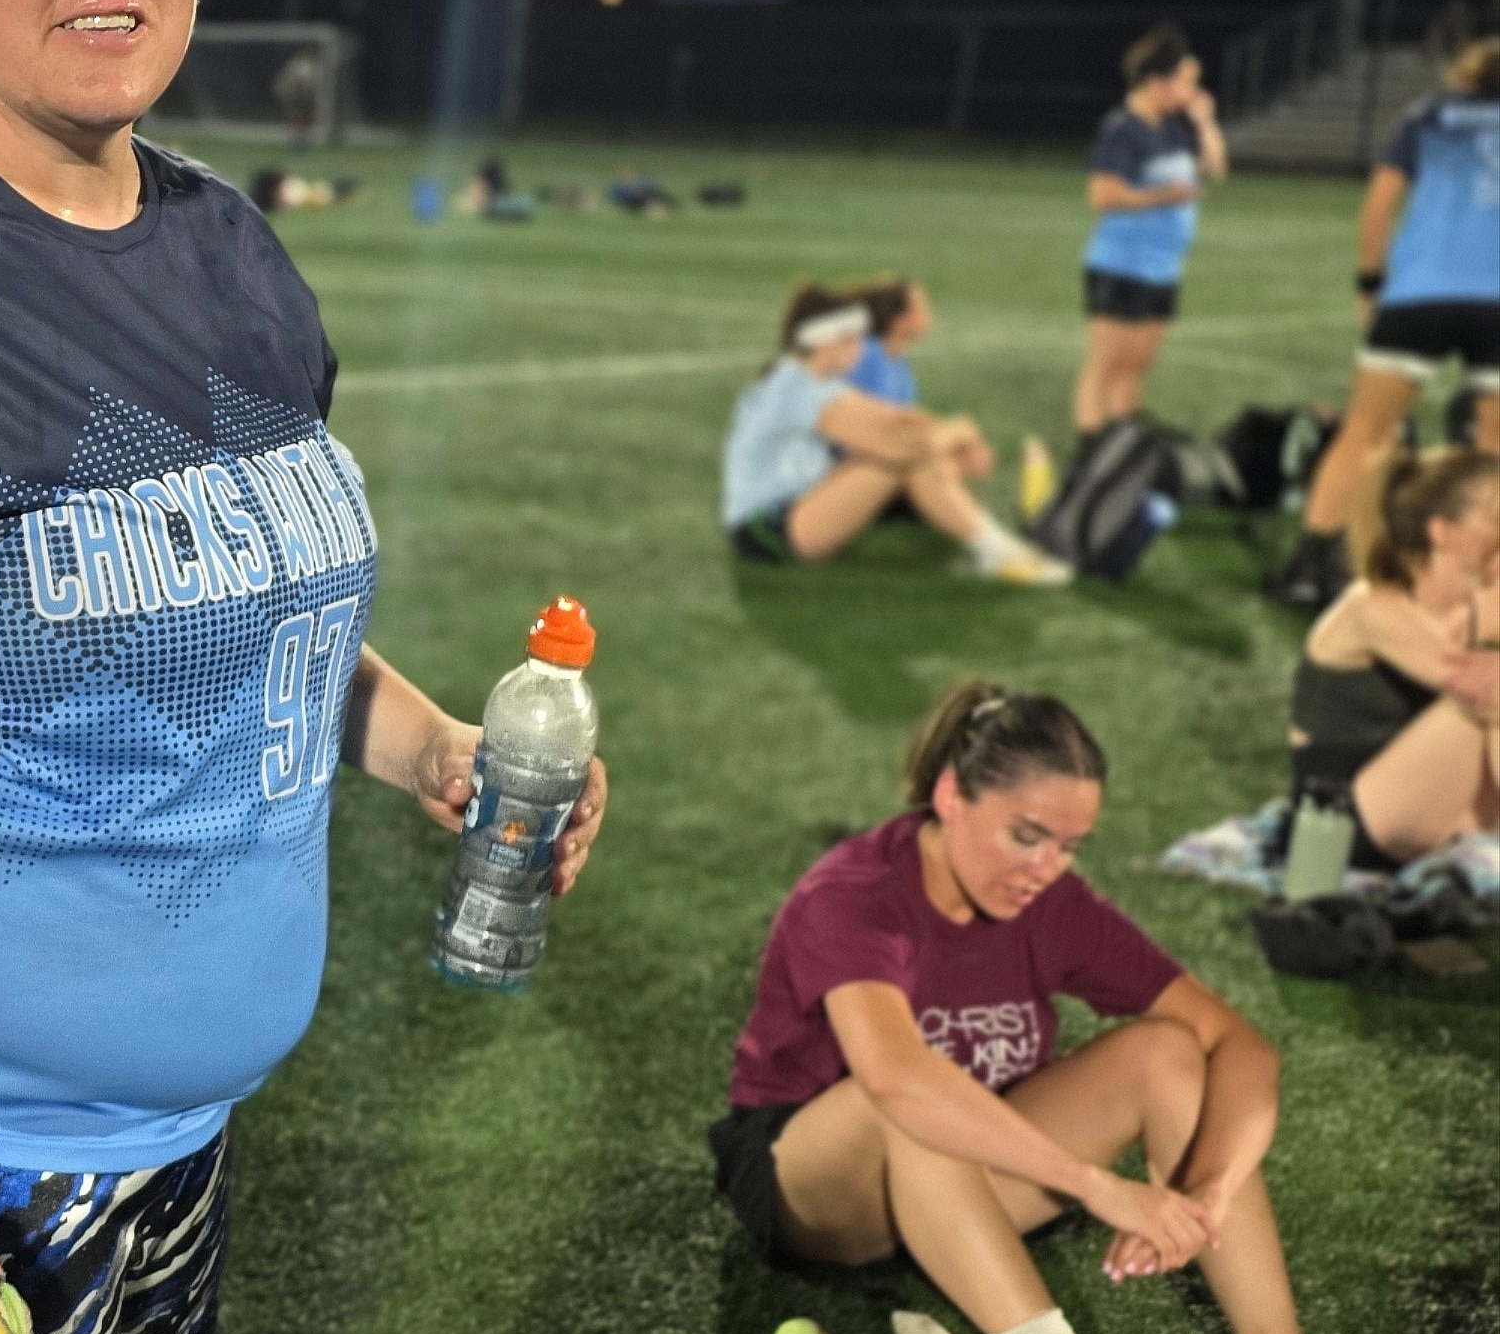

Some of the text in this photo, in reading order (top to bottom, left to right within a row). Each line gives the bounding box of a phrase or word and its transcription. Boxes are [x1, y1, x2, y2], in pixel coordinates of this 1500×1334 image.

[22, 439, 366, 620] CHICKS WITH
[261, 595, 360, 801] 97
